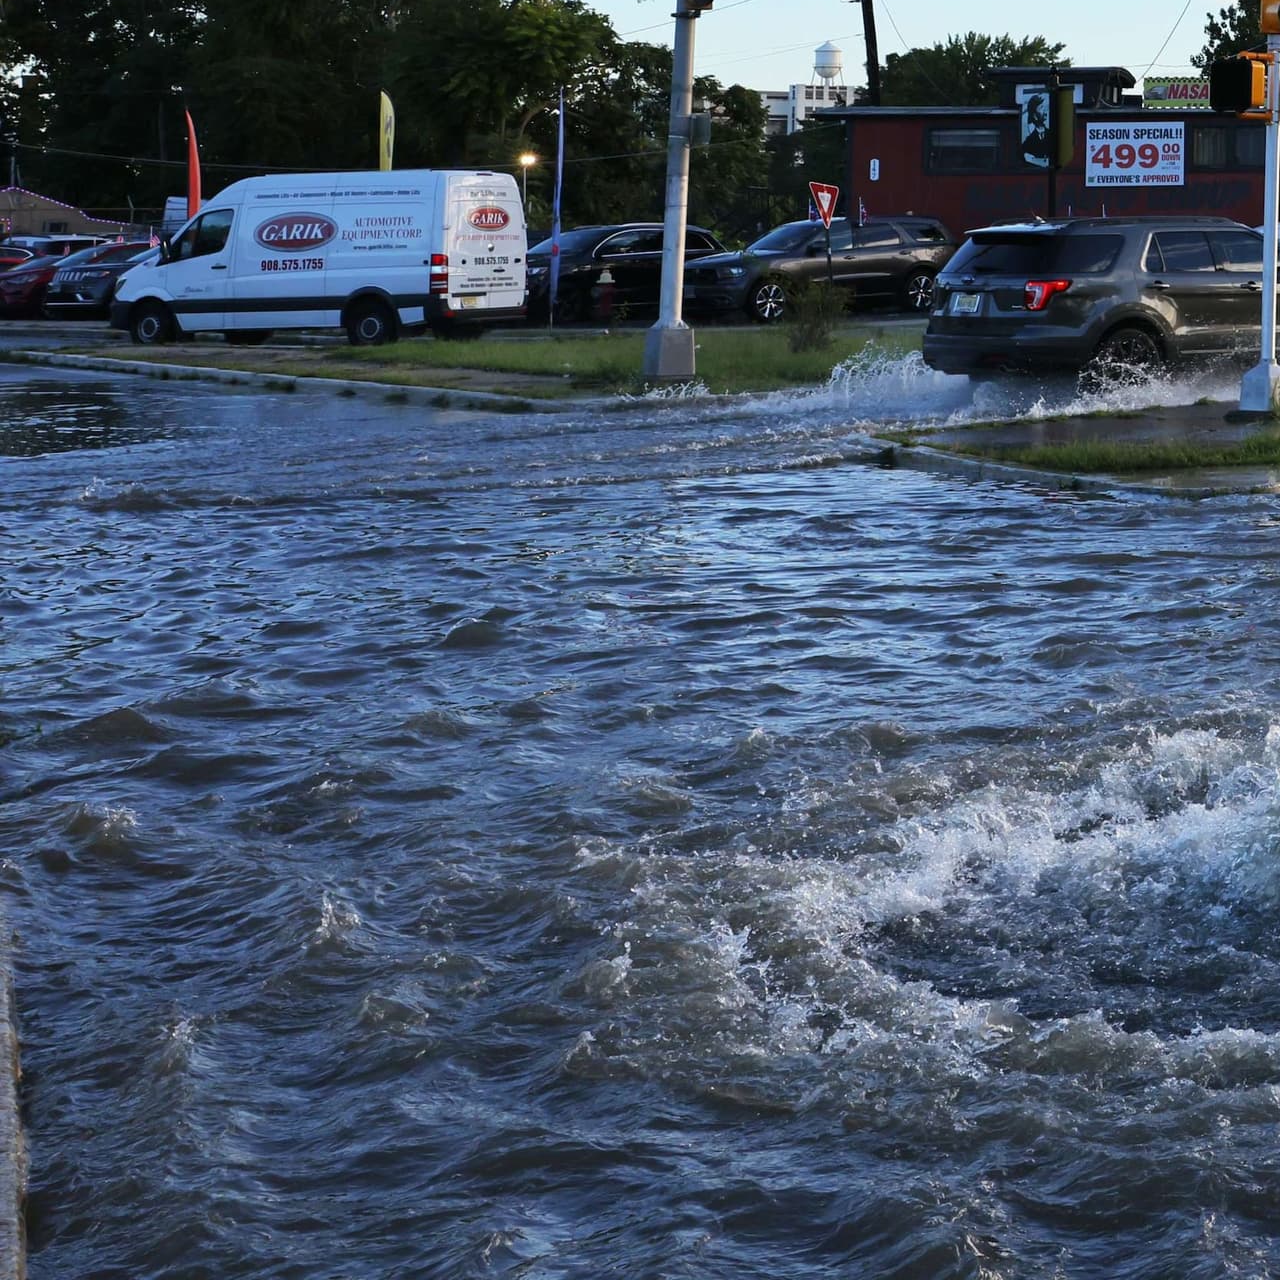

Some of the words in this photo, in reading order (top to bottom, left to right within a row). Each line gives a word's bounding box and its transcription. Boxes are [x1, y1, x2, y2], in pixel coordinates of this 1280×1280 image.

[1167, 83, 1209, 100] NASA
[1089, 129, 1130, 140] SEASON
[1133, 128, 1183, 140] SPECIAL!!
[1097, 175, 1140, 184] EVERYONE'S
[1142, 175, 1180, 183] APPROVED
[354, 216, 414, 228] AUTOMOTIVE
[470, 213, 504, 225] GARIK
[262, 223, 328, 242] GARIK
[341, 229, 396, 241] EQUIPMENT
[260, 258, 323, 272] 908.575.1755
